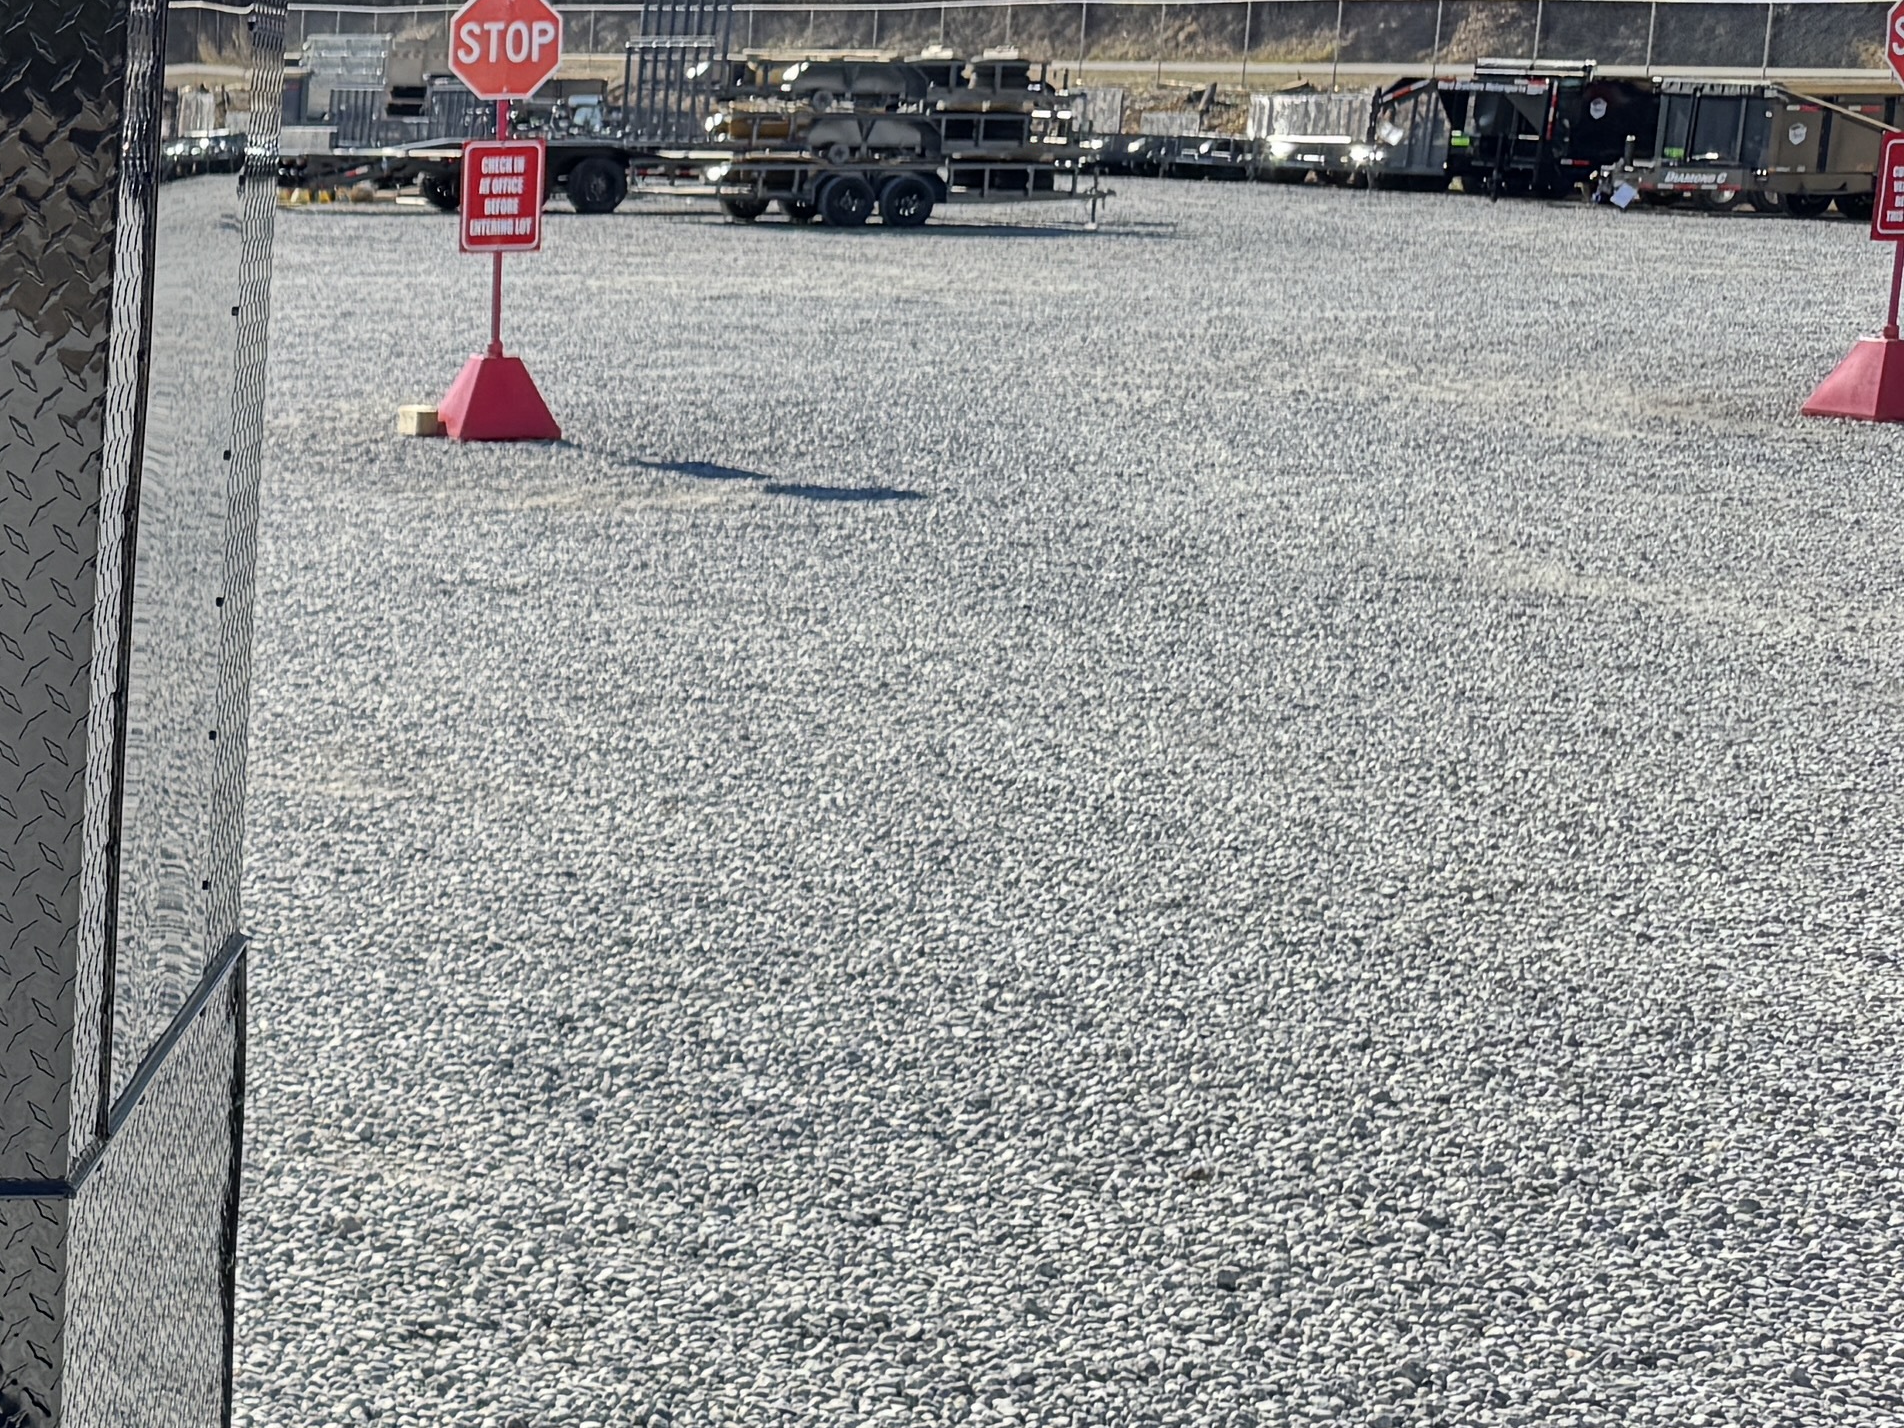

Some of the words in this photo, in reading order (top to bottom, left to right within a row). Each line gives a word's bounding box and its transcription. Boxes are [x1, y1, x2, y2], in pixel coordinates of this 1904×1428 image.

[457, 20, 555, 64] STOP
[481, 155, 512, 174] CHECK
[513, 155, 525, 174] IN
[479, 176, 491, 194] AT
[491, 176, 524, 194] OFFICE
[1664, 171, 1716, 183] DIAMOND
[484, 197, 519, 215] BEFORE
[469, 218, 513, 236] ENTERING
[514, 217, 532, 235] LOT
